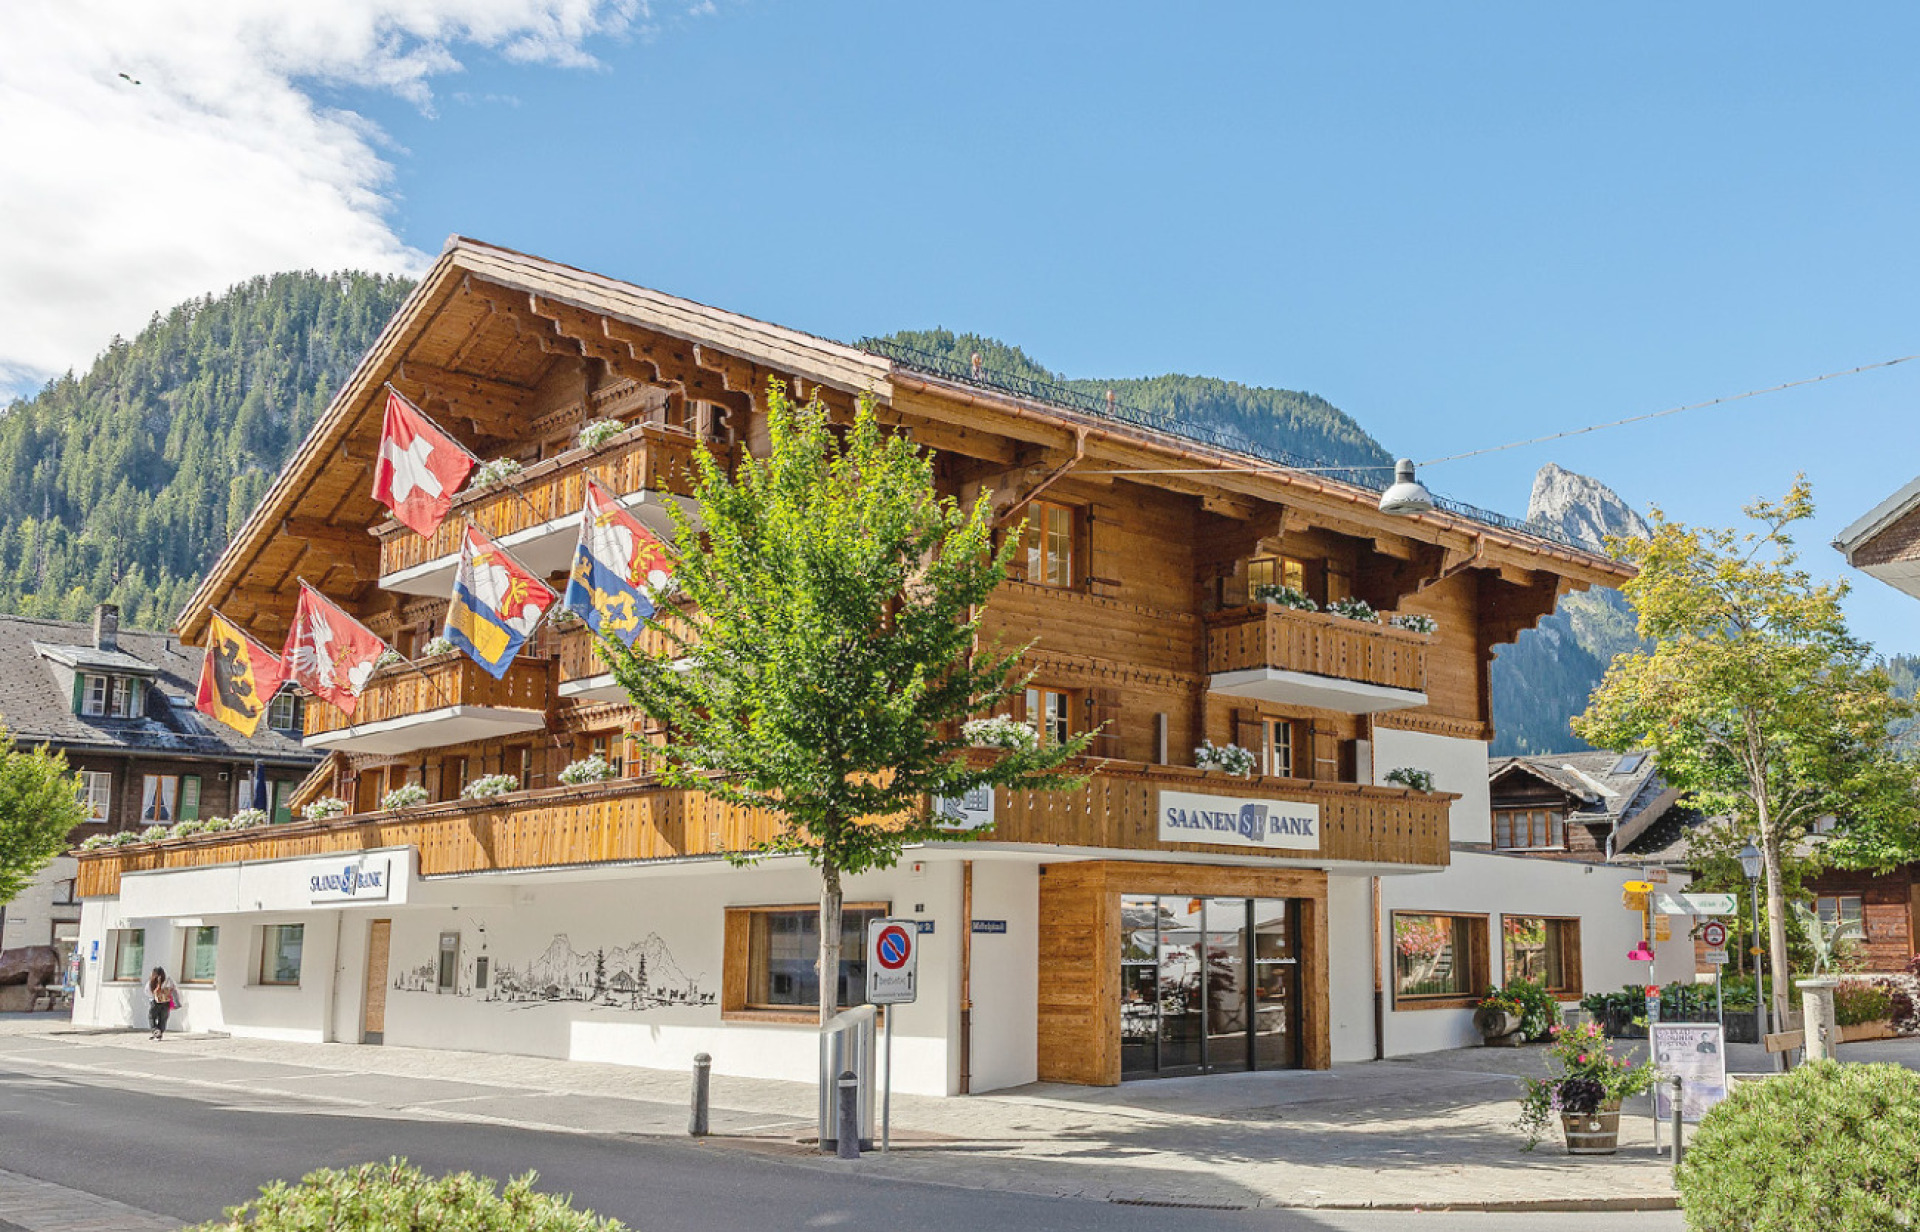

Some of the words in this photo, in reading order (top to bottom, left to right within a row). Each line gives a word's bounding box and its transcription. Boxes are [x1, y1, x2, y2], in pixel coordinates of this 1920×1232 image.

[1166, 808, 1238, 832] SAANEN
[1269, 815, 1314, 836] BANK
[310, 874, 342, 892] SAANEN
[358, 871, 382, 889] BANK
